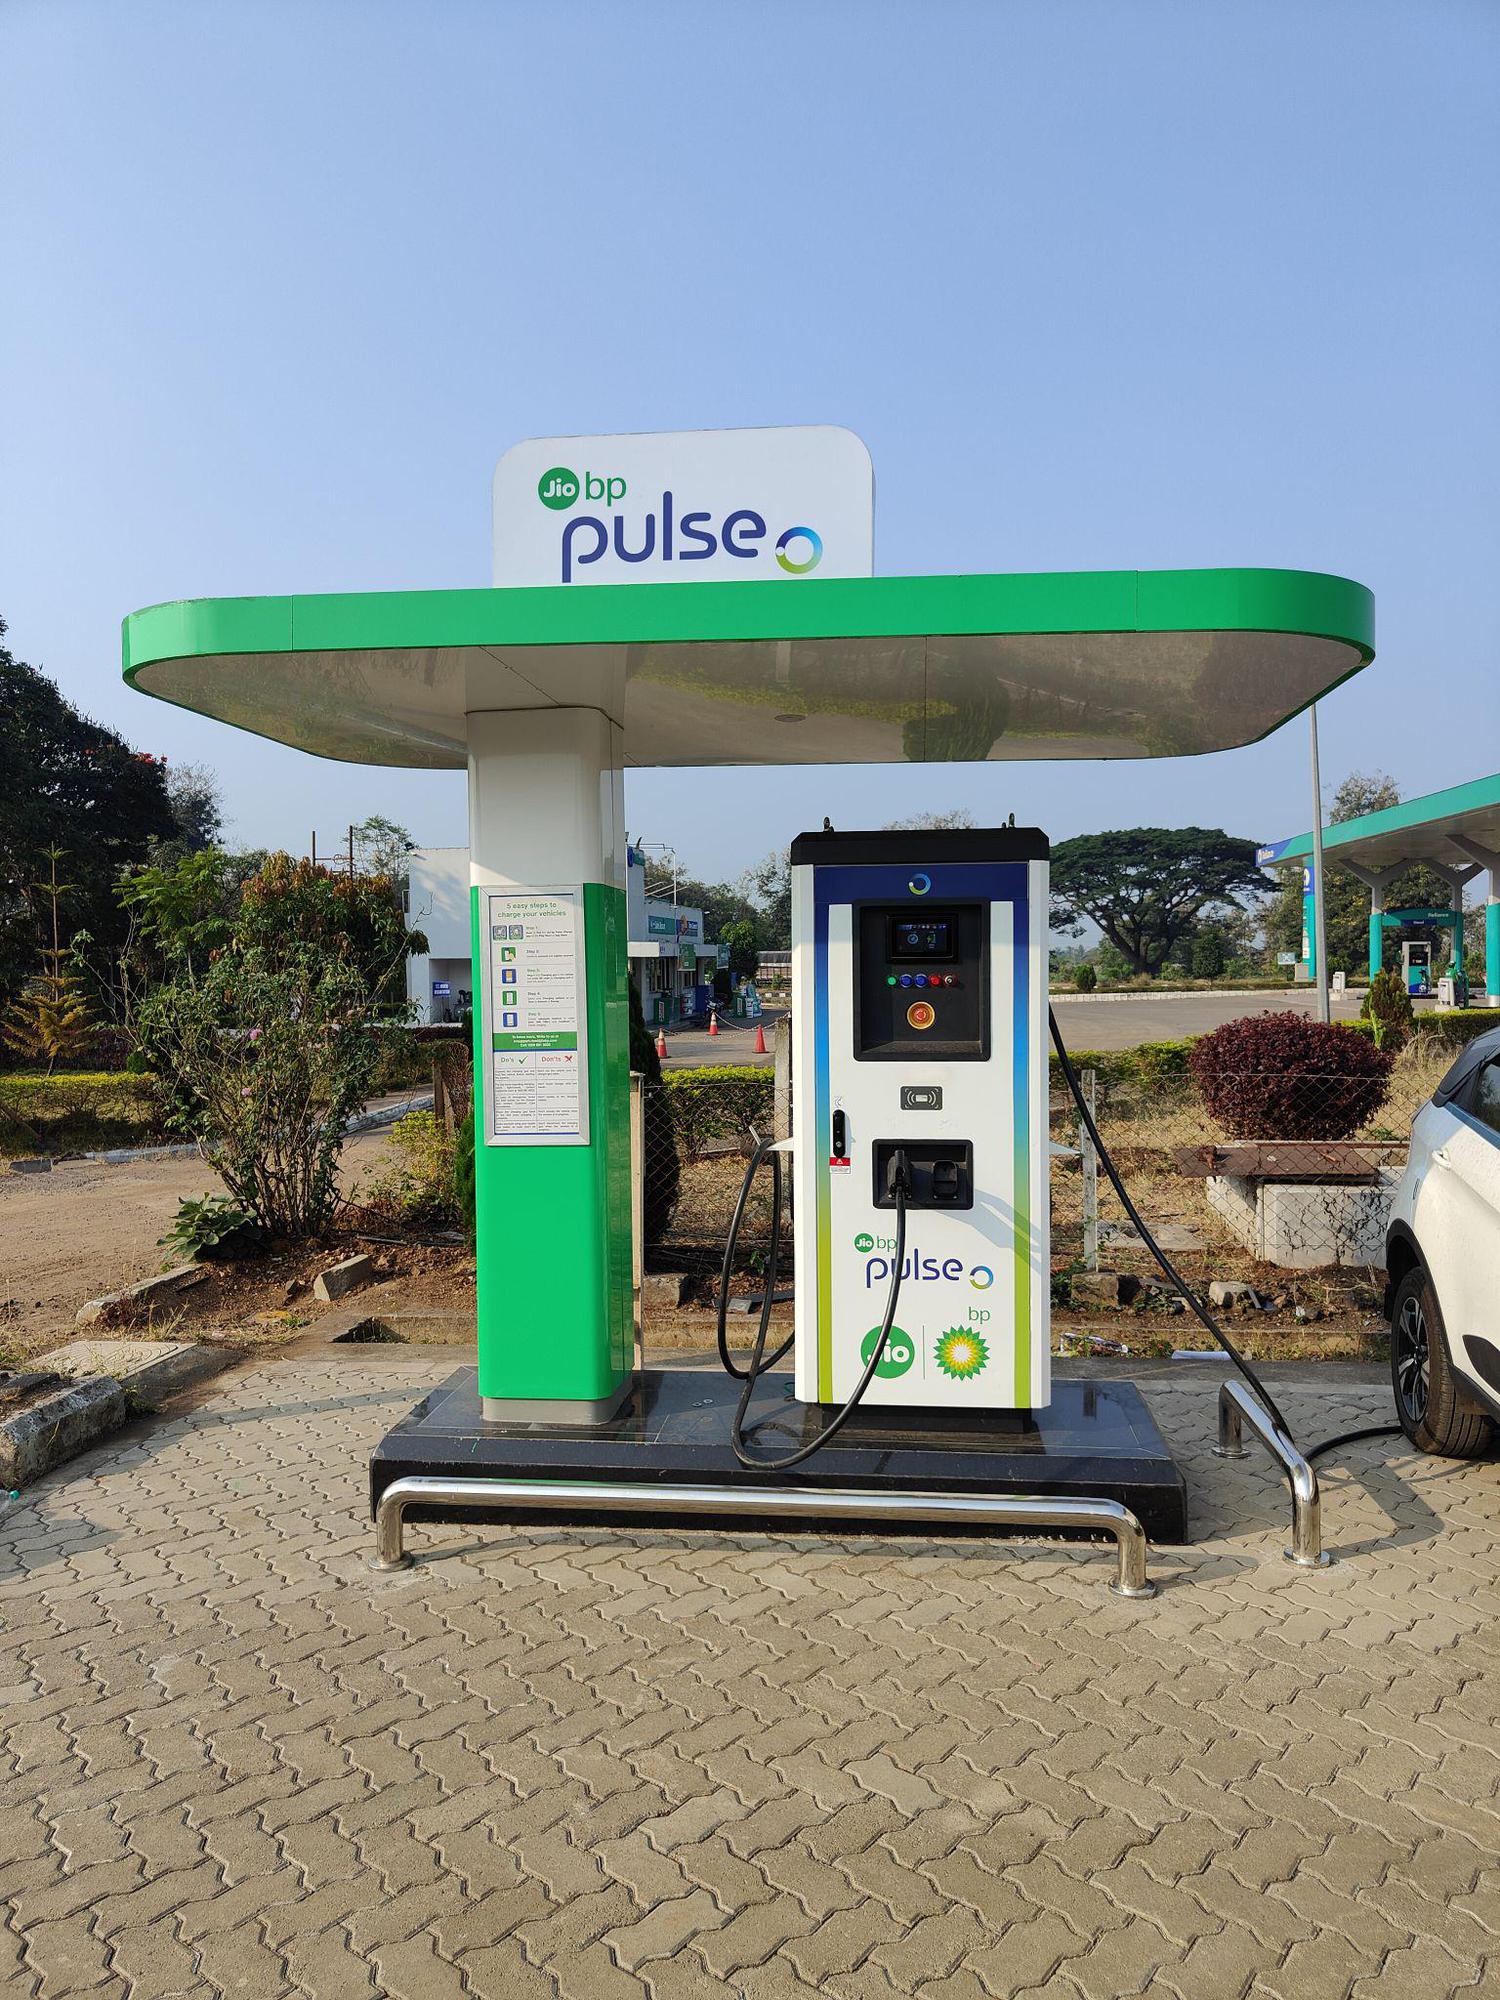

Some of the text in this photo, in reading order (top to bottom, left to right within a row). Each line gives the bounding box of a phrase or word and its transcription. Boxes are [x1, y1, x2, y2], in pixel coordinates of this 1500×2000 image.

[543, 471, 627, 507] Jio bp
[561, 490, 767, 584] pulse
[497, 909, 567, 919] charge your vehicles
[529, 902, 548, 910] steps
[876, 1235, 897, 1252] bp
[866, 1248, 964, 1288] pulse
[968, 1306, 991, 1325] bp
[867, 1338, 910, 1364] io
